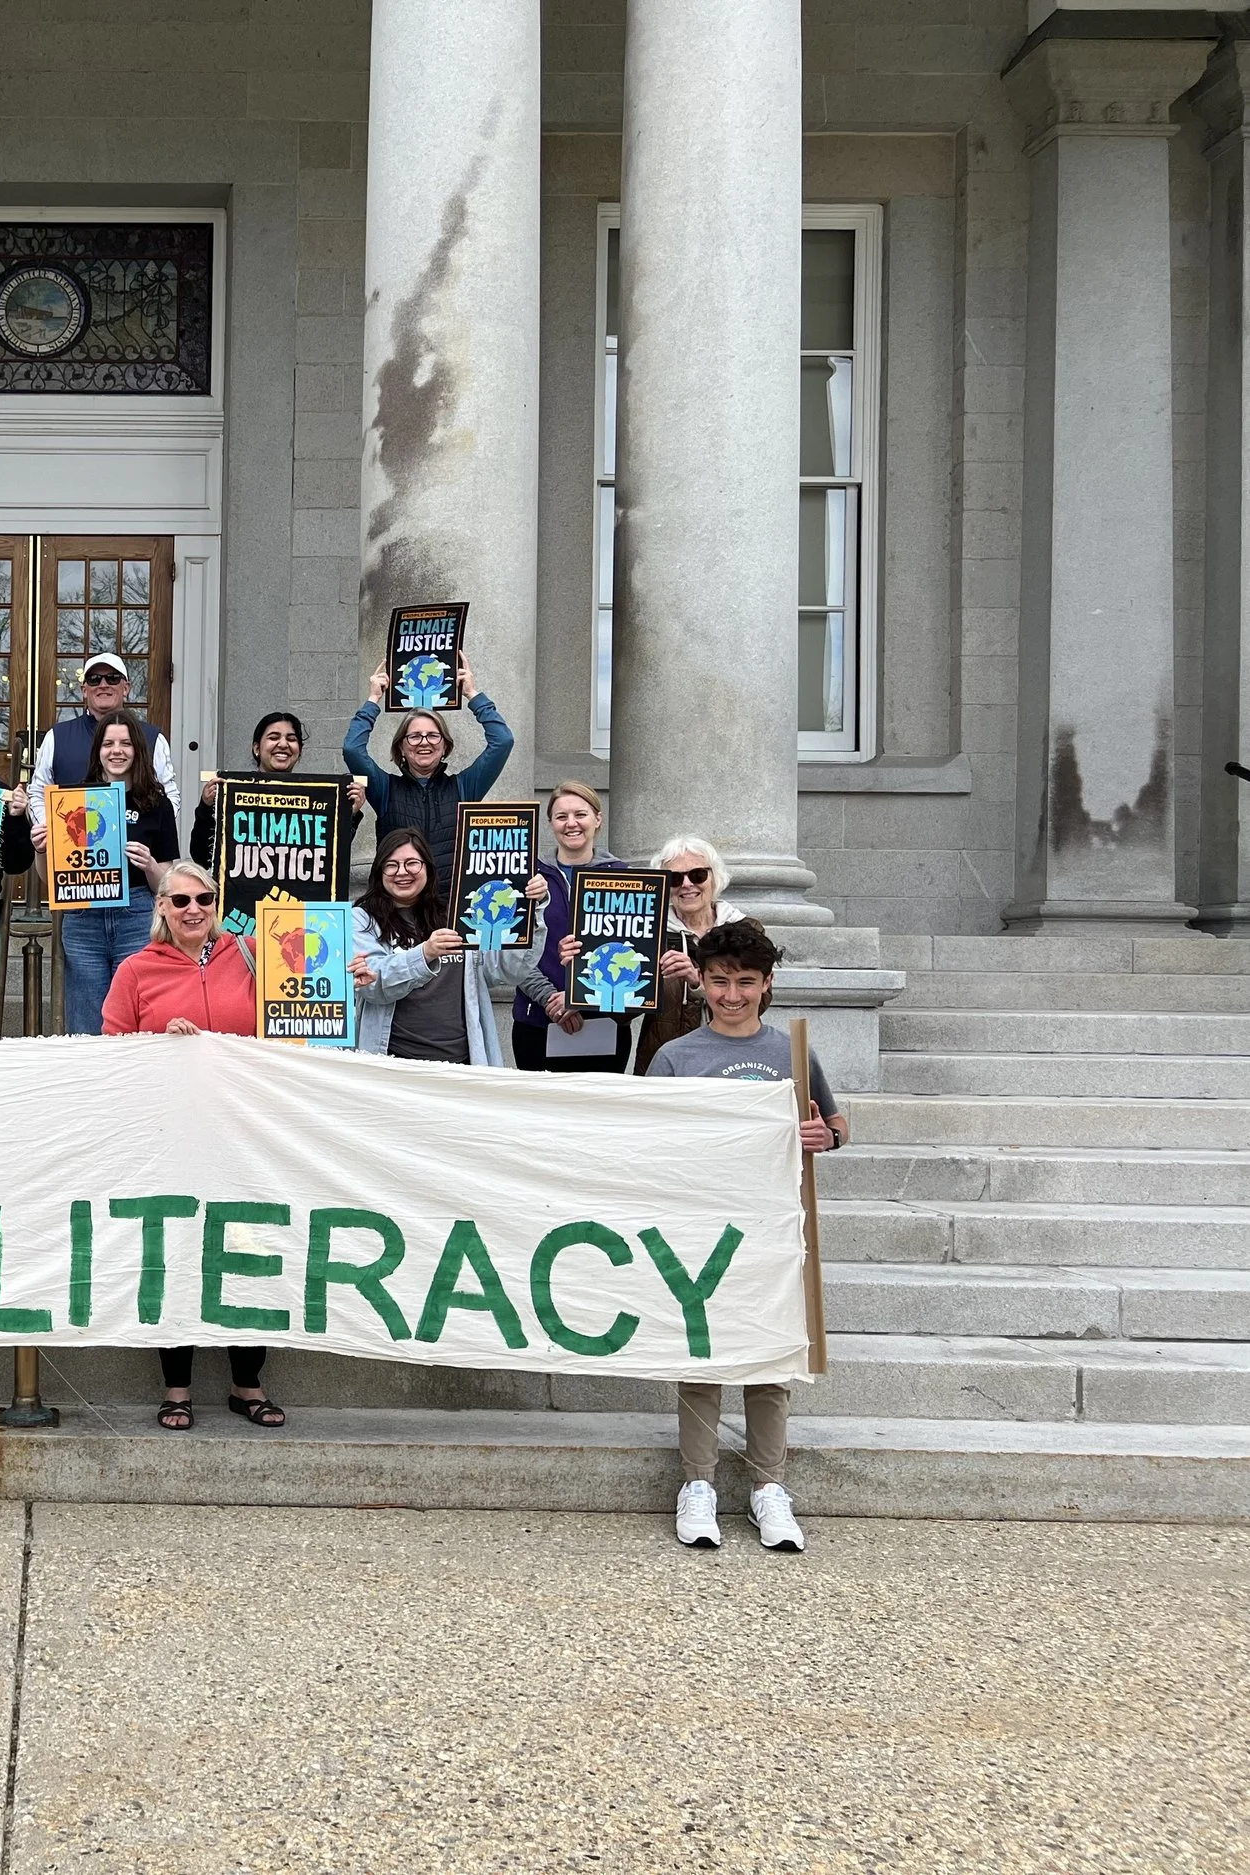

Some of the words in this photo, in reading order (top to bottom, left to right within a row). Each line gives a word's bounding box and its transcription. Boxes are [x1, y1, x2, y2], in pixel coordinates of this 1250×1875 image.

[399, 618, 457, 635] CLIMATE
[397, 633, 454, 652] JUSTICE
[236, 794, 272, 804] PEOPLE
[274, 797, 308, 807] POWER
[312, 801, 328, 810] for
[233, 811, 327, 847] CLIMATE
[469, 829, 528, 851] CLIMATE
[230, 844, 326, 882] JUSTICE
[466, 852, 528, 875] JUSTICE
[57, 871, 119, 885] CLIMATE
[58, 885, 94, 900] ACTION
[96, 884, 120, 898] NOW
[583, 891, 656, 914] CLIMATE
[581, 914, 655, 938] JUSTICE
[268, 1003, 343, 1017] CLIMATE
[267, 1018, 312, 1035] ACTION
[315, 1019, 344, 1035] NOW
[722, 1062, 778, 1077] ORGANIZING
